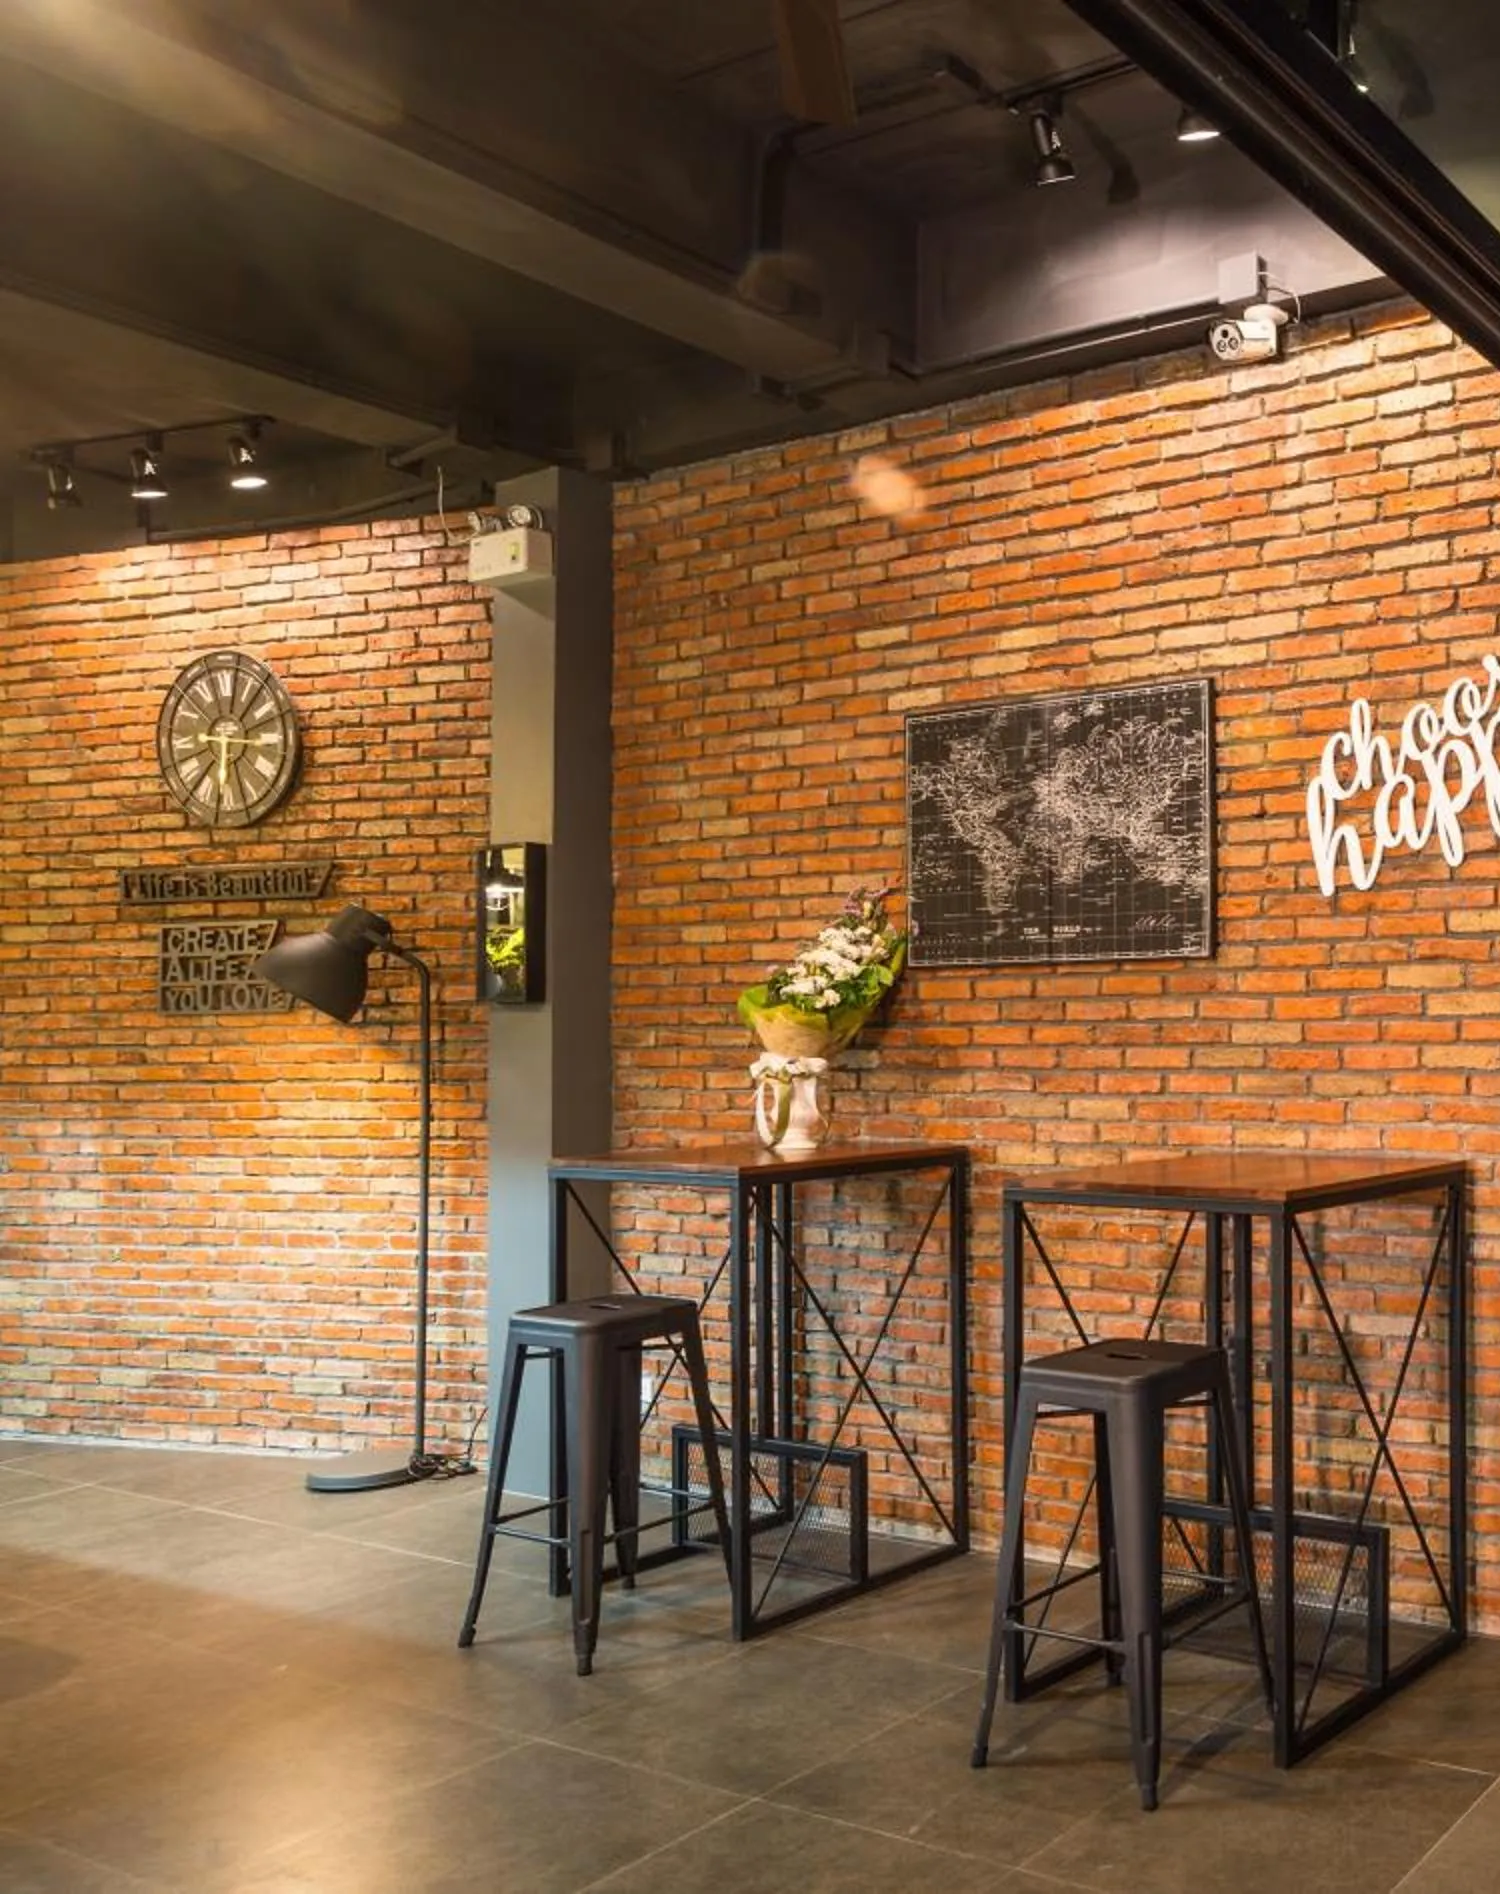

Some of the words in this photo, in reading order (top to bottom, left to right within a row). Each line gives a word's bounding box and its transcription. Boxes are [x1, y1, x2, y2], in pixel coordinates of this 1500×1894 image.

[168, 925, 258, 954] CREATE
[166, 955, 183, 982] A
[189, 955, 241, 982] LIFE
[166, 985, 213, 1011] YOU
[221, 985, 283, 1011] LOVE
